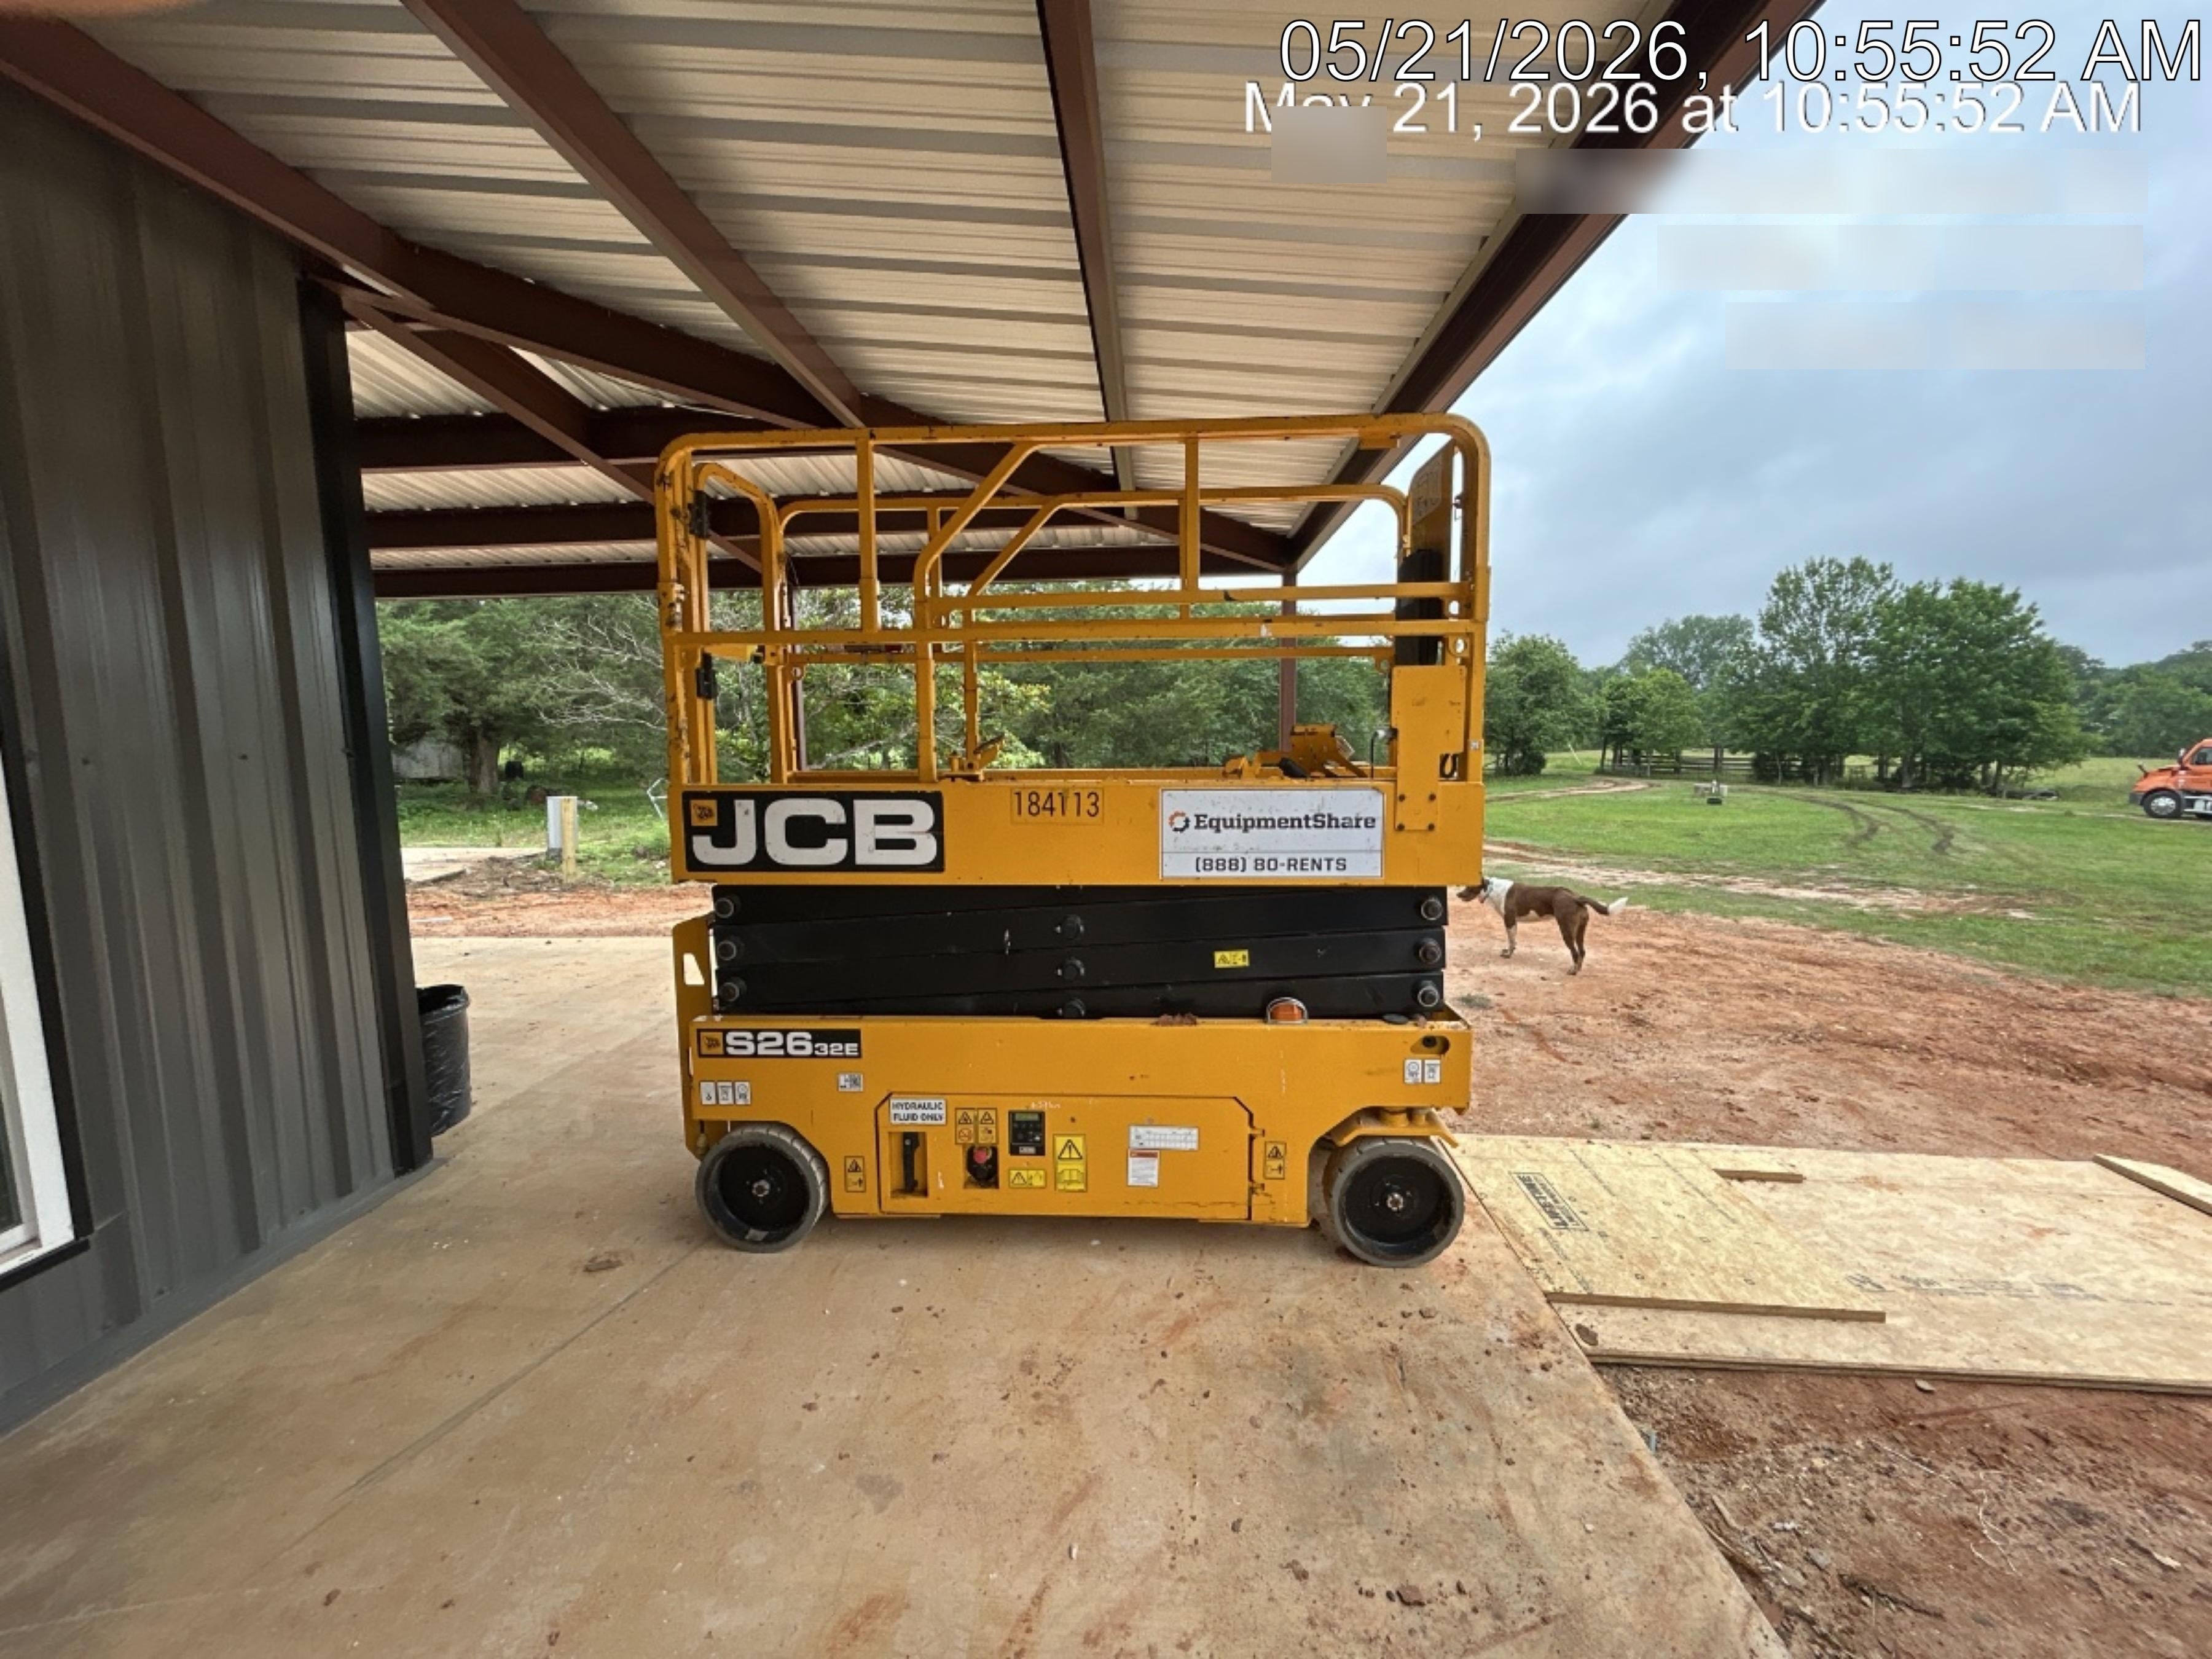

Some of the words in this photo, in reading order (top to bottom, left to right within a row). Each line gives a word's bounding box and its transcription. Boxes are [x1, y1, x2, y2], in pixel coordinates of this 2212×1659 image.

[1014, 791, 1099, 817] 184113
[692, 798, 937, 865] JCB
[1194, 813, 1376, 833] EquipmentShare
[1195, 857, 1246, 872] (888)
[1254, 857, 1347, 871] 80-RENTS
